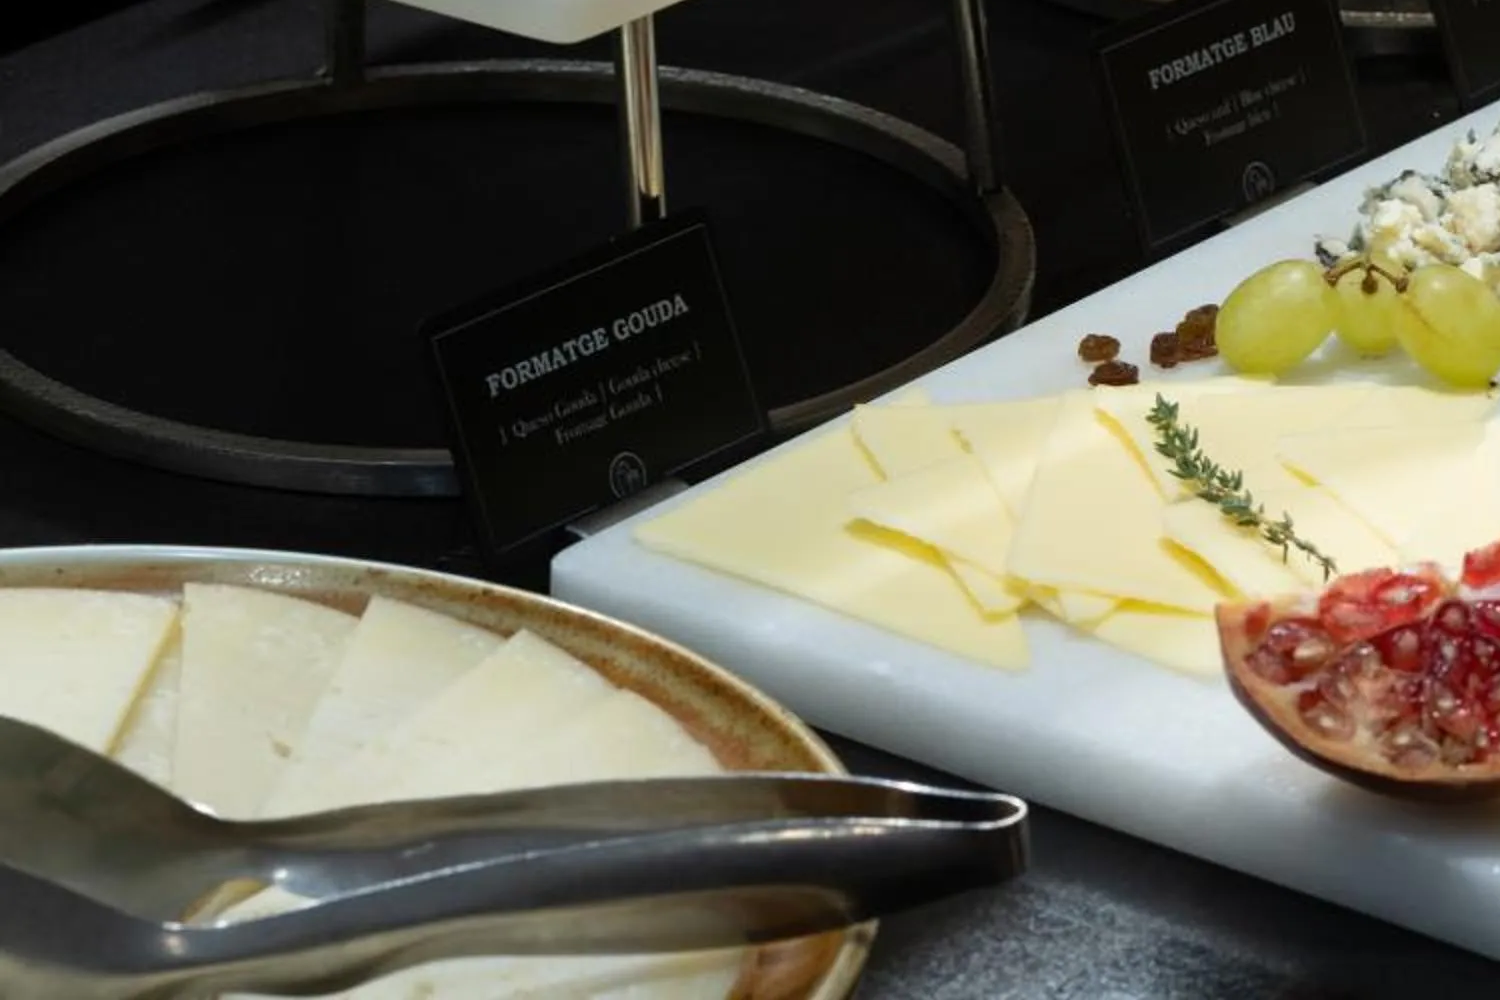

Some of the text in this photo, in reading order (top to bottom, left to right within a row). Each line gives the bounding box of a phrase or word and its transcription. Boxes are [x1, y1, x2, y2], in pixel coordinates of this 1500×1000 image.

[1148, 12, 1296, 90] FORMATGE BLAU
[485, 293, 690, 398] FORMATGE GOUDA
